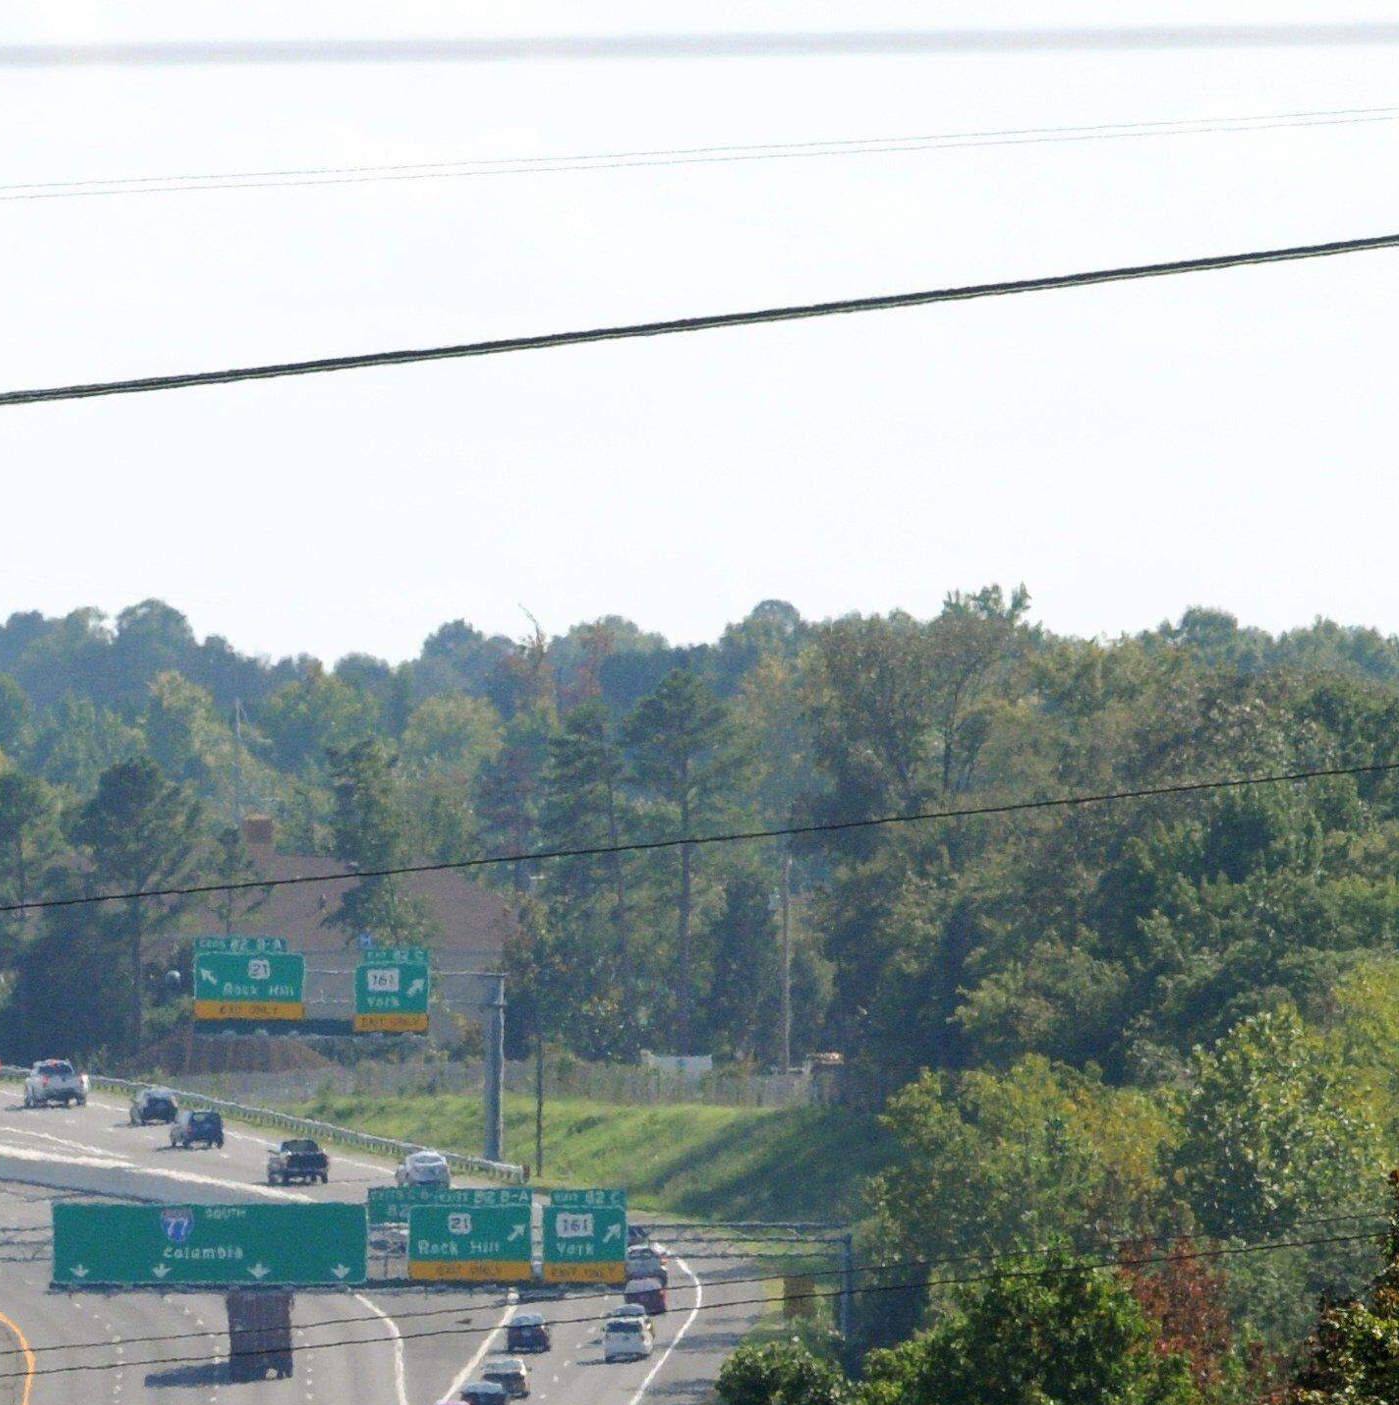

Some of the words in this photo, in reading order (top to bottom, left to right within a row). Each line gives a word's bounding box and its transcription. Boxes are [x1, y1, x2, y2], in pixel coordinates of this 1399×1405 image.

[230, 938, 249, 951] 82
[251, 961, 269, 975] 21
[371, 973, 396, 988] 161
[223, 982, 258, 996] Rock
[268, 984, 295, 997] Hill
[366, 997, 401, 1008] York
[474, 1190, 496, 1204] 82
[501, 1190, 529, 1203] B-A
[585, 1190, 605, 1204] 82
[166, 1217, 189, 1239] 77
[205, 1207, 248, 1219] SOUTH
[450, 1216, 470, 1231] 21
[561, 1218, 589, 1233] 161
[162, 1246, 245, 1260] Columbia
[418, 1240, 459, 1256] Rock
[470, 1241, 500, 1254] Hill
[556, 1241, 595, 1256] York
